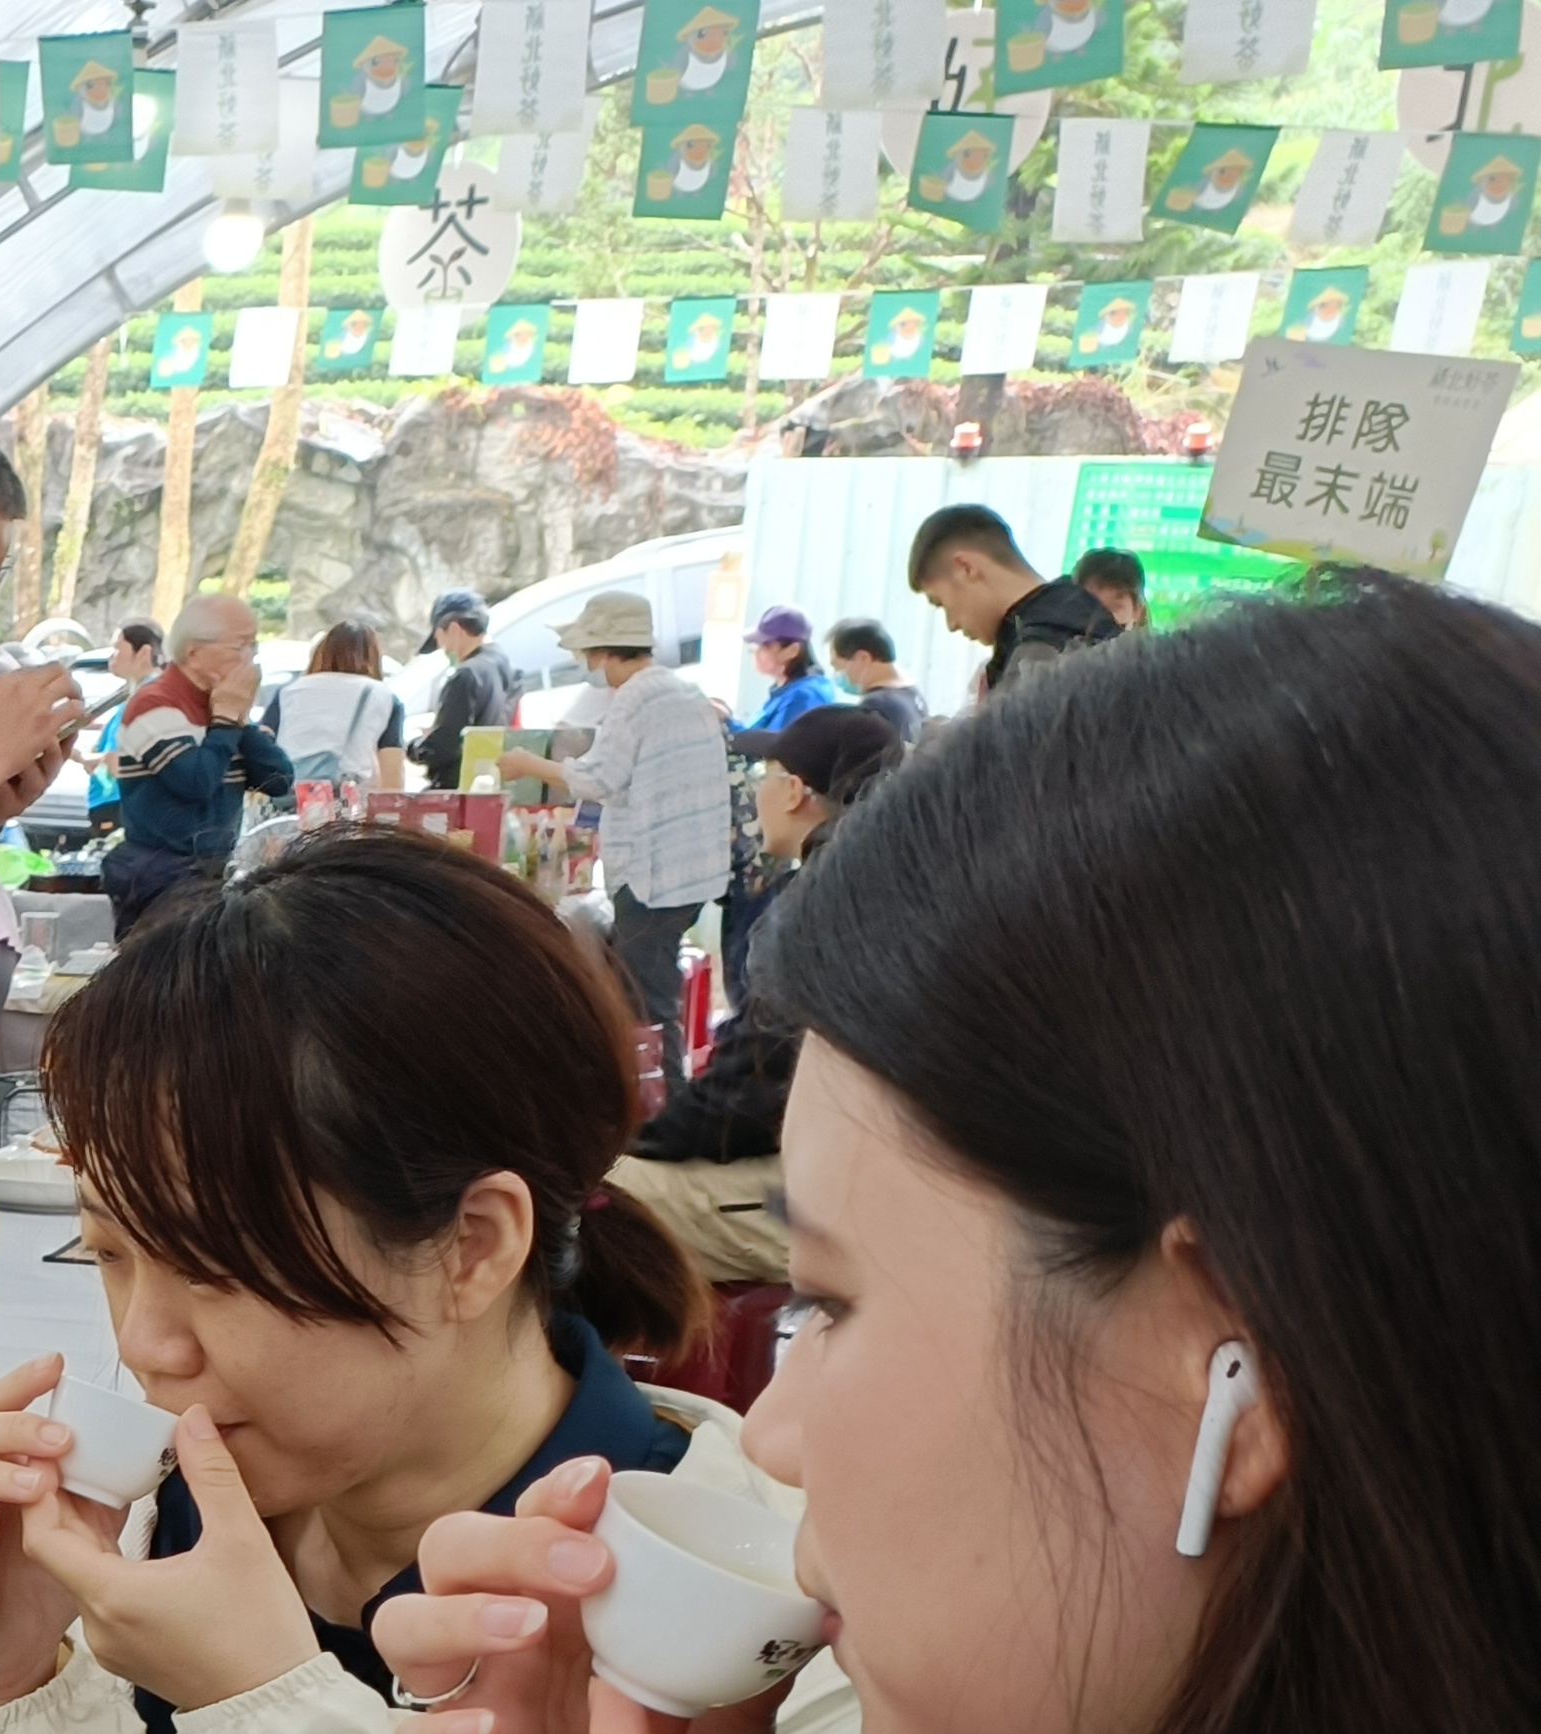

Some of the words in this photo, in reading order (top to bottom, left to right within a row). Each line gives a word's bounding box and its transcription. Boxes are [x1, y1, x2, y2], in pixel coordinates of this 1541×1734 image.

[1295, 391, 1411, 453] 排隊
[1249, 450, 1419, 530] 最末端
